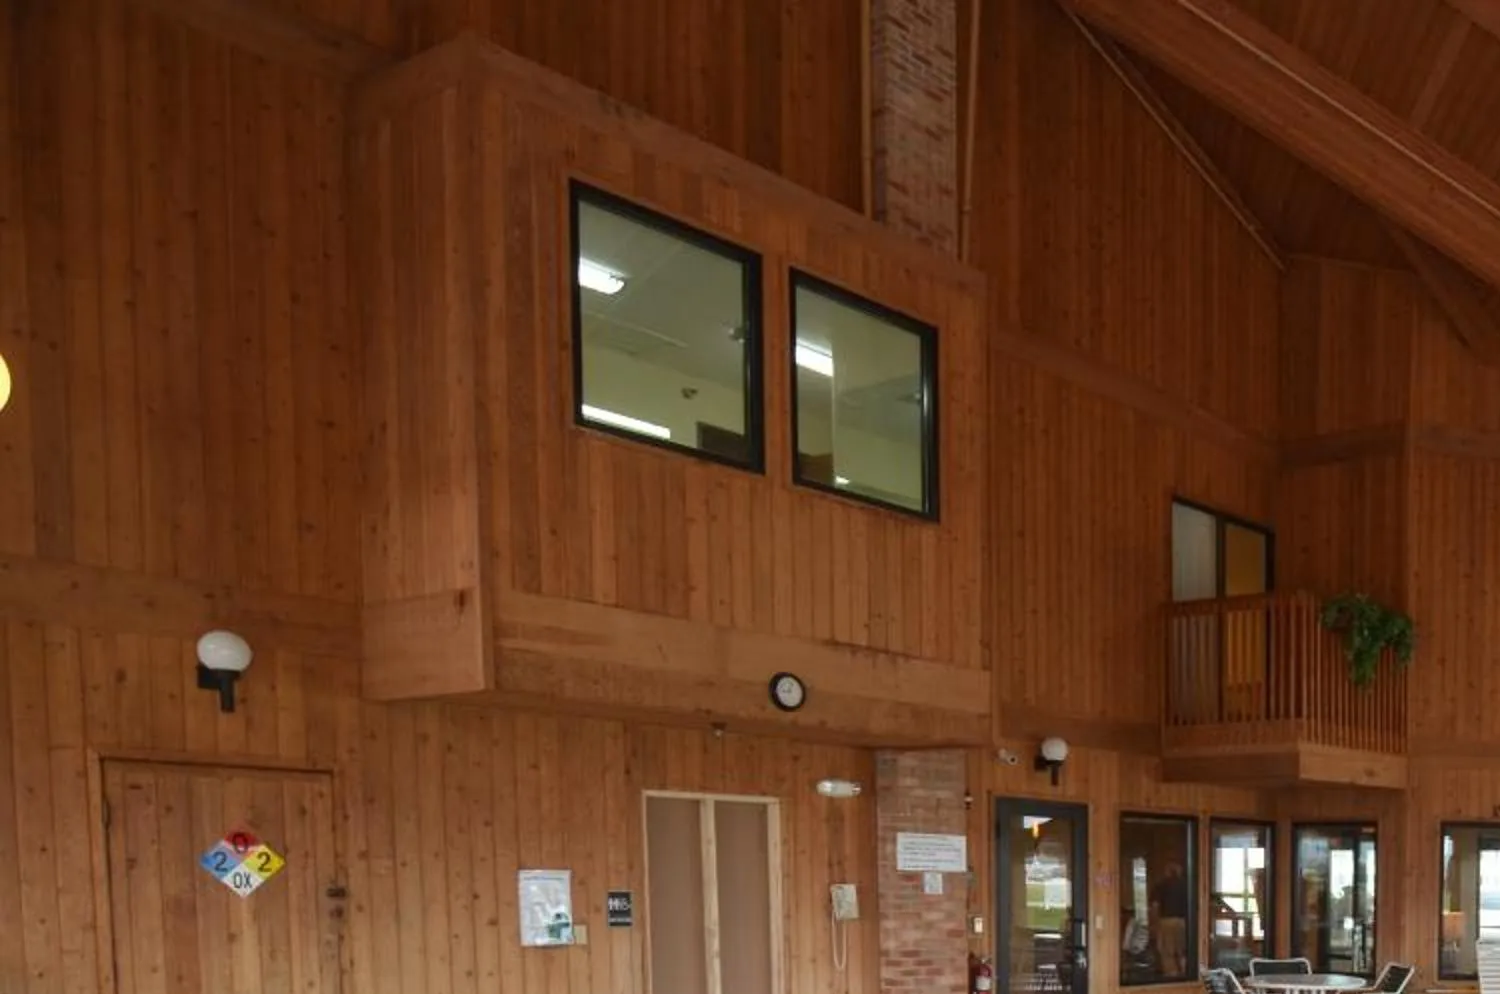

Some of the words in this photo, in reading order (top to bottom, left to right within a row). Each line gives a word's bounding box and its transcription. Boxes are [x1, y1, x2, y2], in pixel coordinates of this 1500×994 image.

[231, 832, 248, 854] 0
[212, 851, 229, 873] 2
[257, 851, 273, 873] 2
[233, 871, 253, 889] OX
